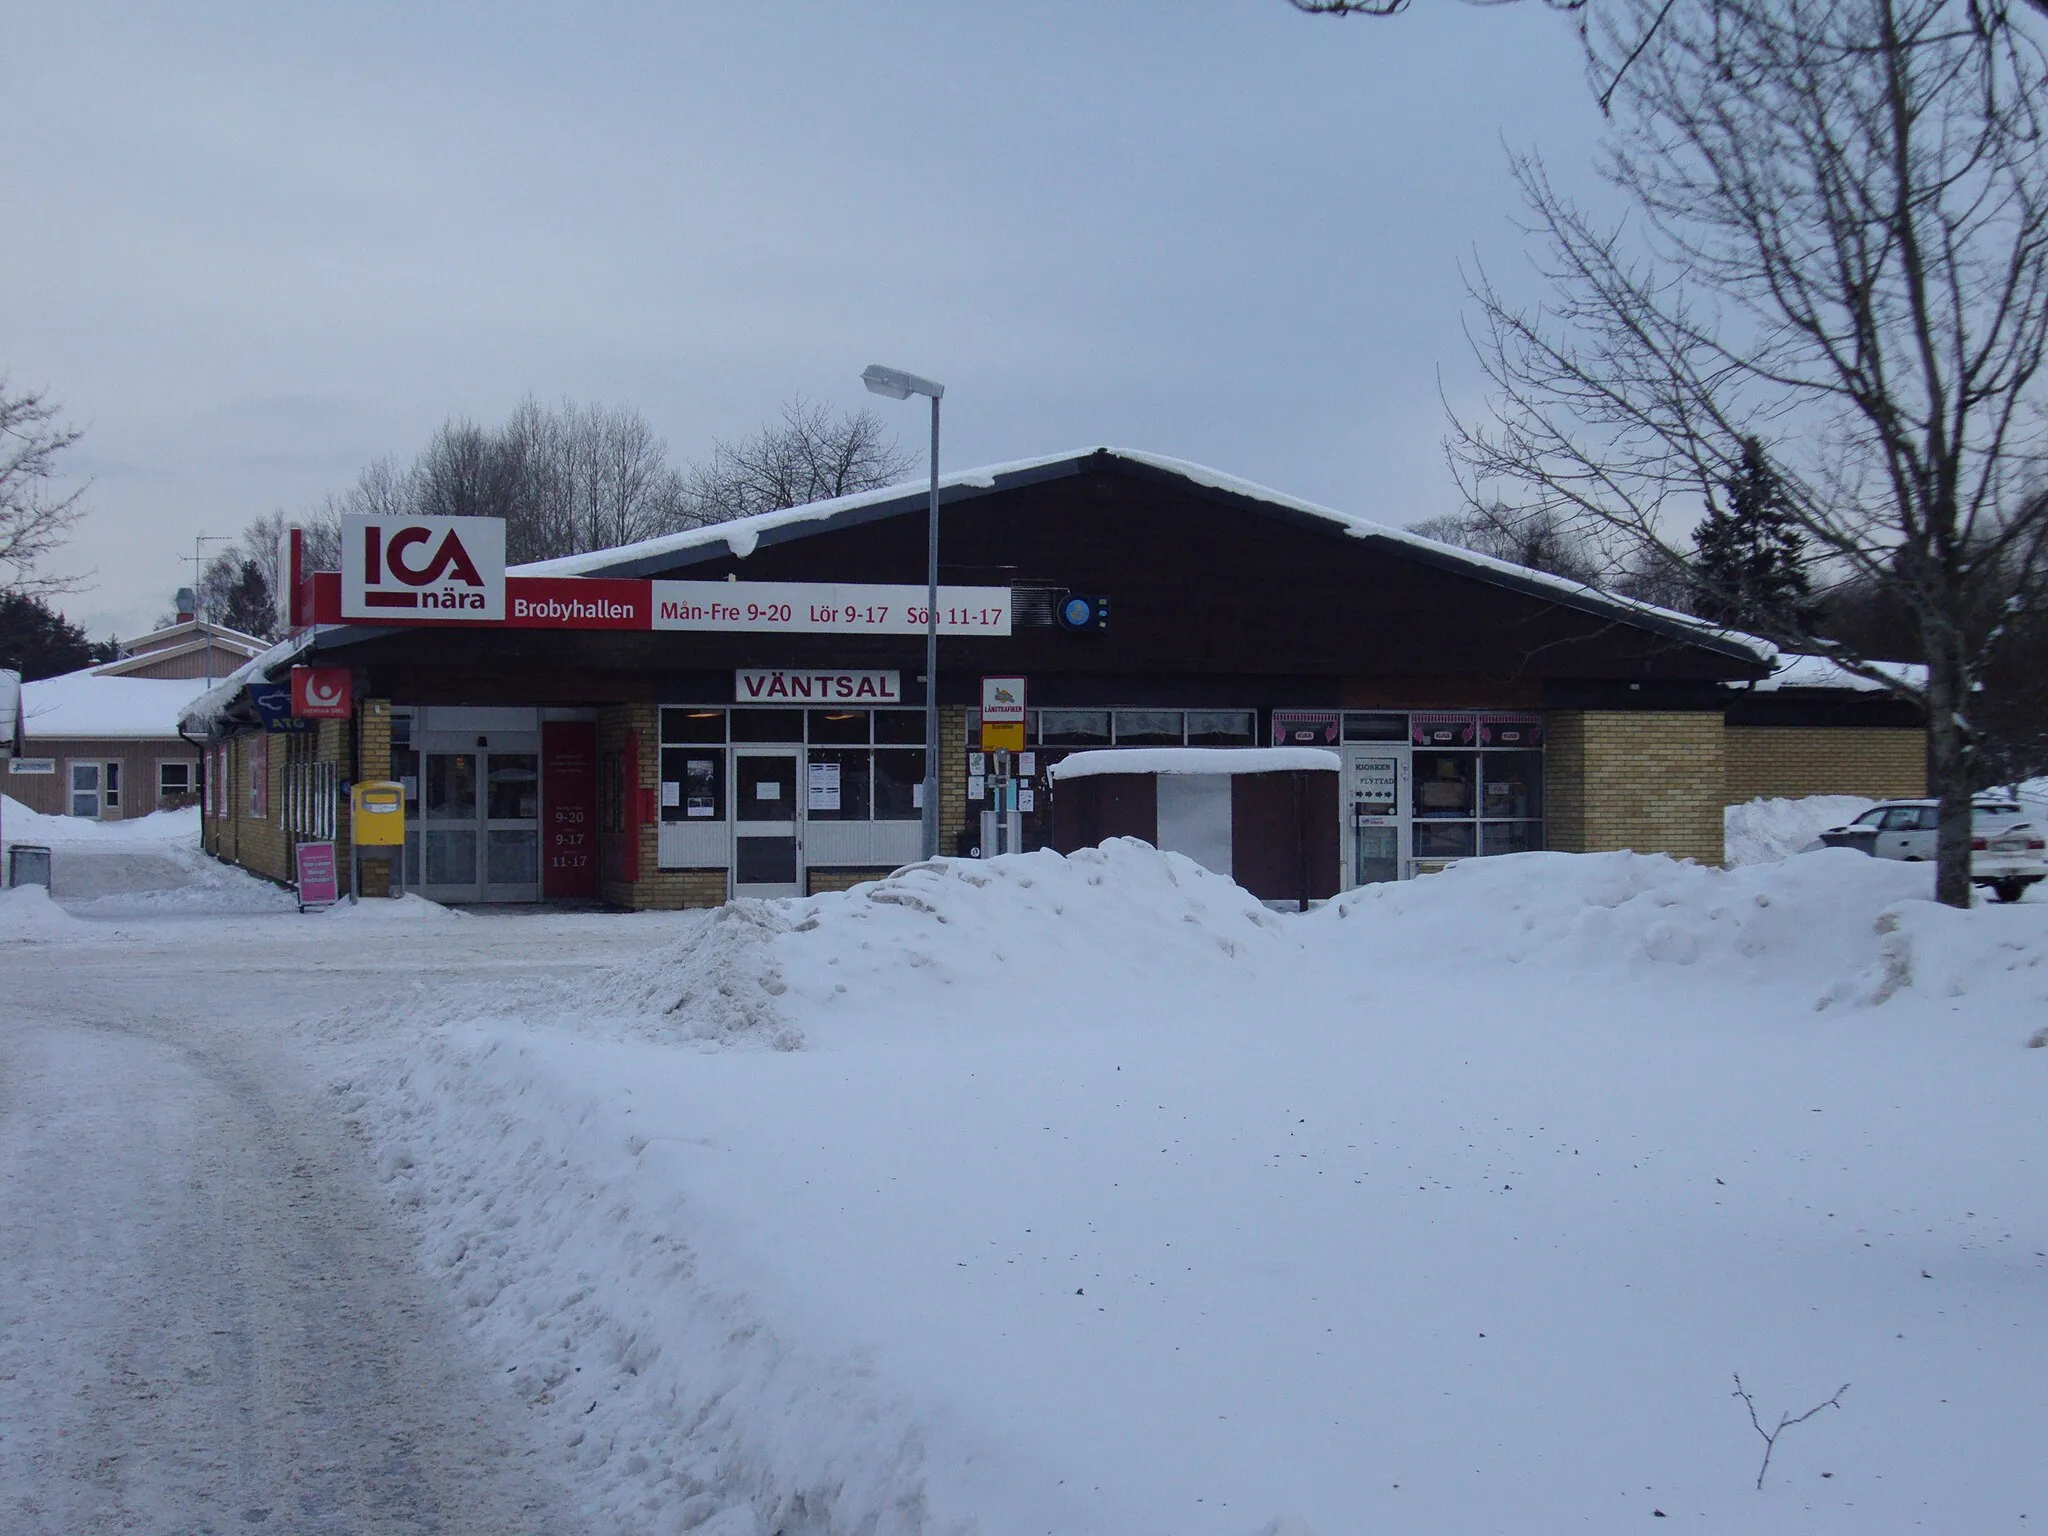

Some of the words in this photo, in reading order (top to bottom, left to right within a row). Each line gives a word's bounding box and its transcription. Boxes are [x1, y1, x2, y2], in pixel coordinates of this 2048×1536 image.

[364, 526, 486, 587] ICA
[421, 586, 486, 610] nära
[513, 598, 635, 622] Brobyhallen
[660, 600, 740, 622] Mån-Fre
[747, 603, 792, 623] 9-20
[809, 604, 839, 623] Lör
[845, 605, 889, 624] 9-17
[948, 607, 1003, 626] 11-17
[743, 671, 895, 698] VÄNTSAL
[984, 704, 1022, 713] LÄNSTRAFIKEN
[271, 718, 305, 729] ATG
[1355, 763, 1391, 771] KIOSKEN
[555, 811, 584, 823] 9-20
[555, 834, 584, 845] 9-17
[551, 856, 588, 868] 11-17
